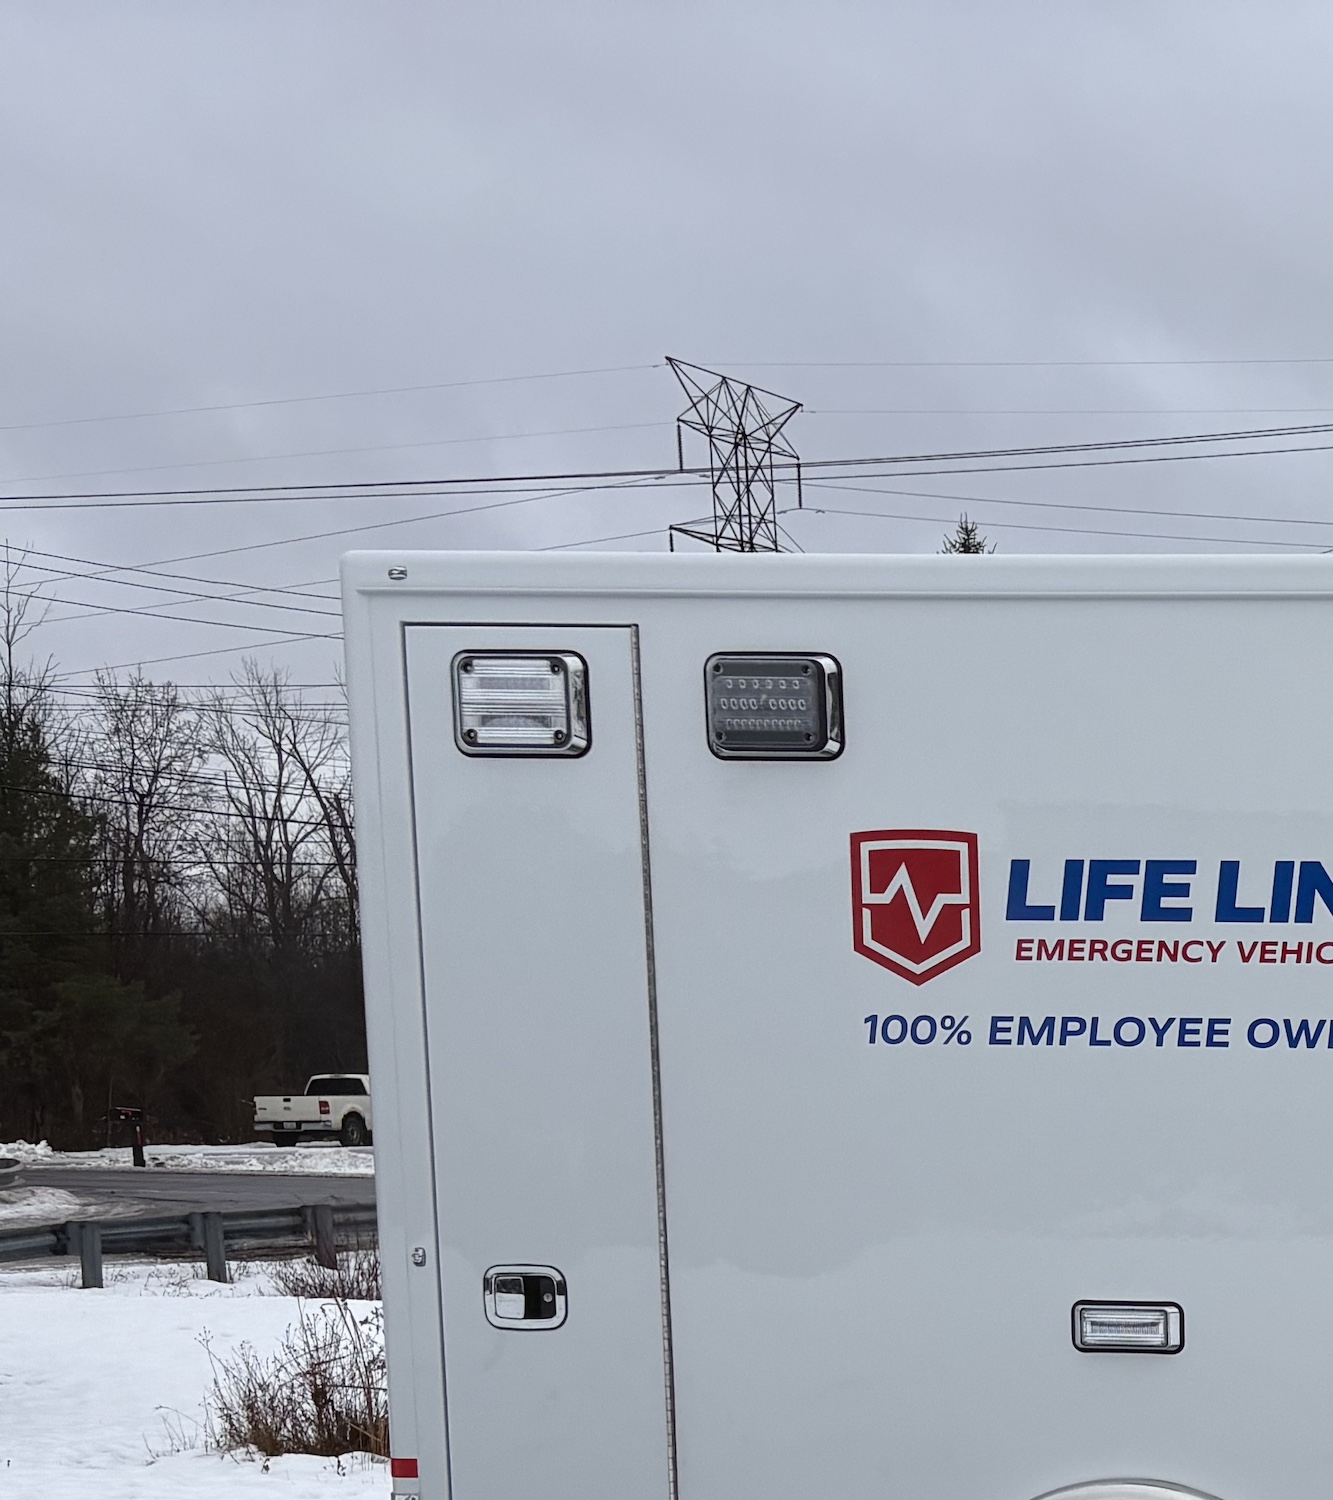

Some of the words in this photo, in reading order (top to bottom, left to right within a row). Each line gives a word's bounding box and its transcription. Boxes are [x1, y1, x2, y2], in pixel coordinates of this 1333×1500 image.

[1005, 858, 1198, 923] LIFE
[1015, 938, 1227, 964] EMERGENCY
[863, 1014, 973, 1046] 100%
[988, 1015, 1232, 1048] EMPLOYEE
